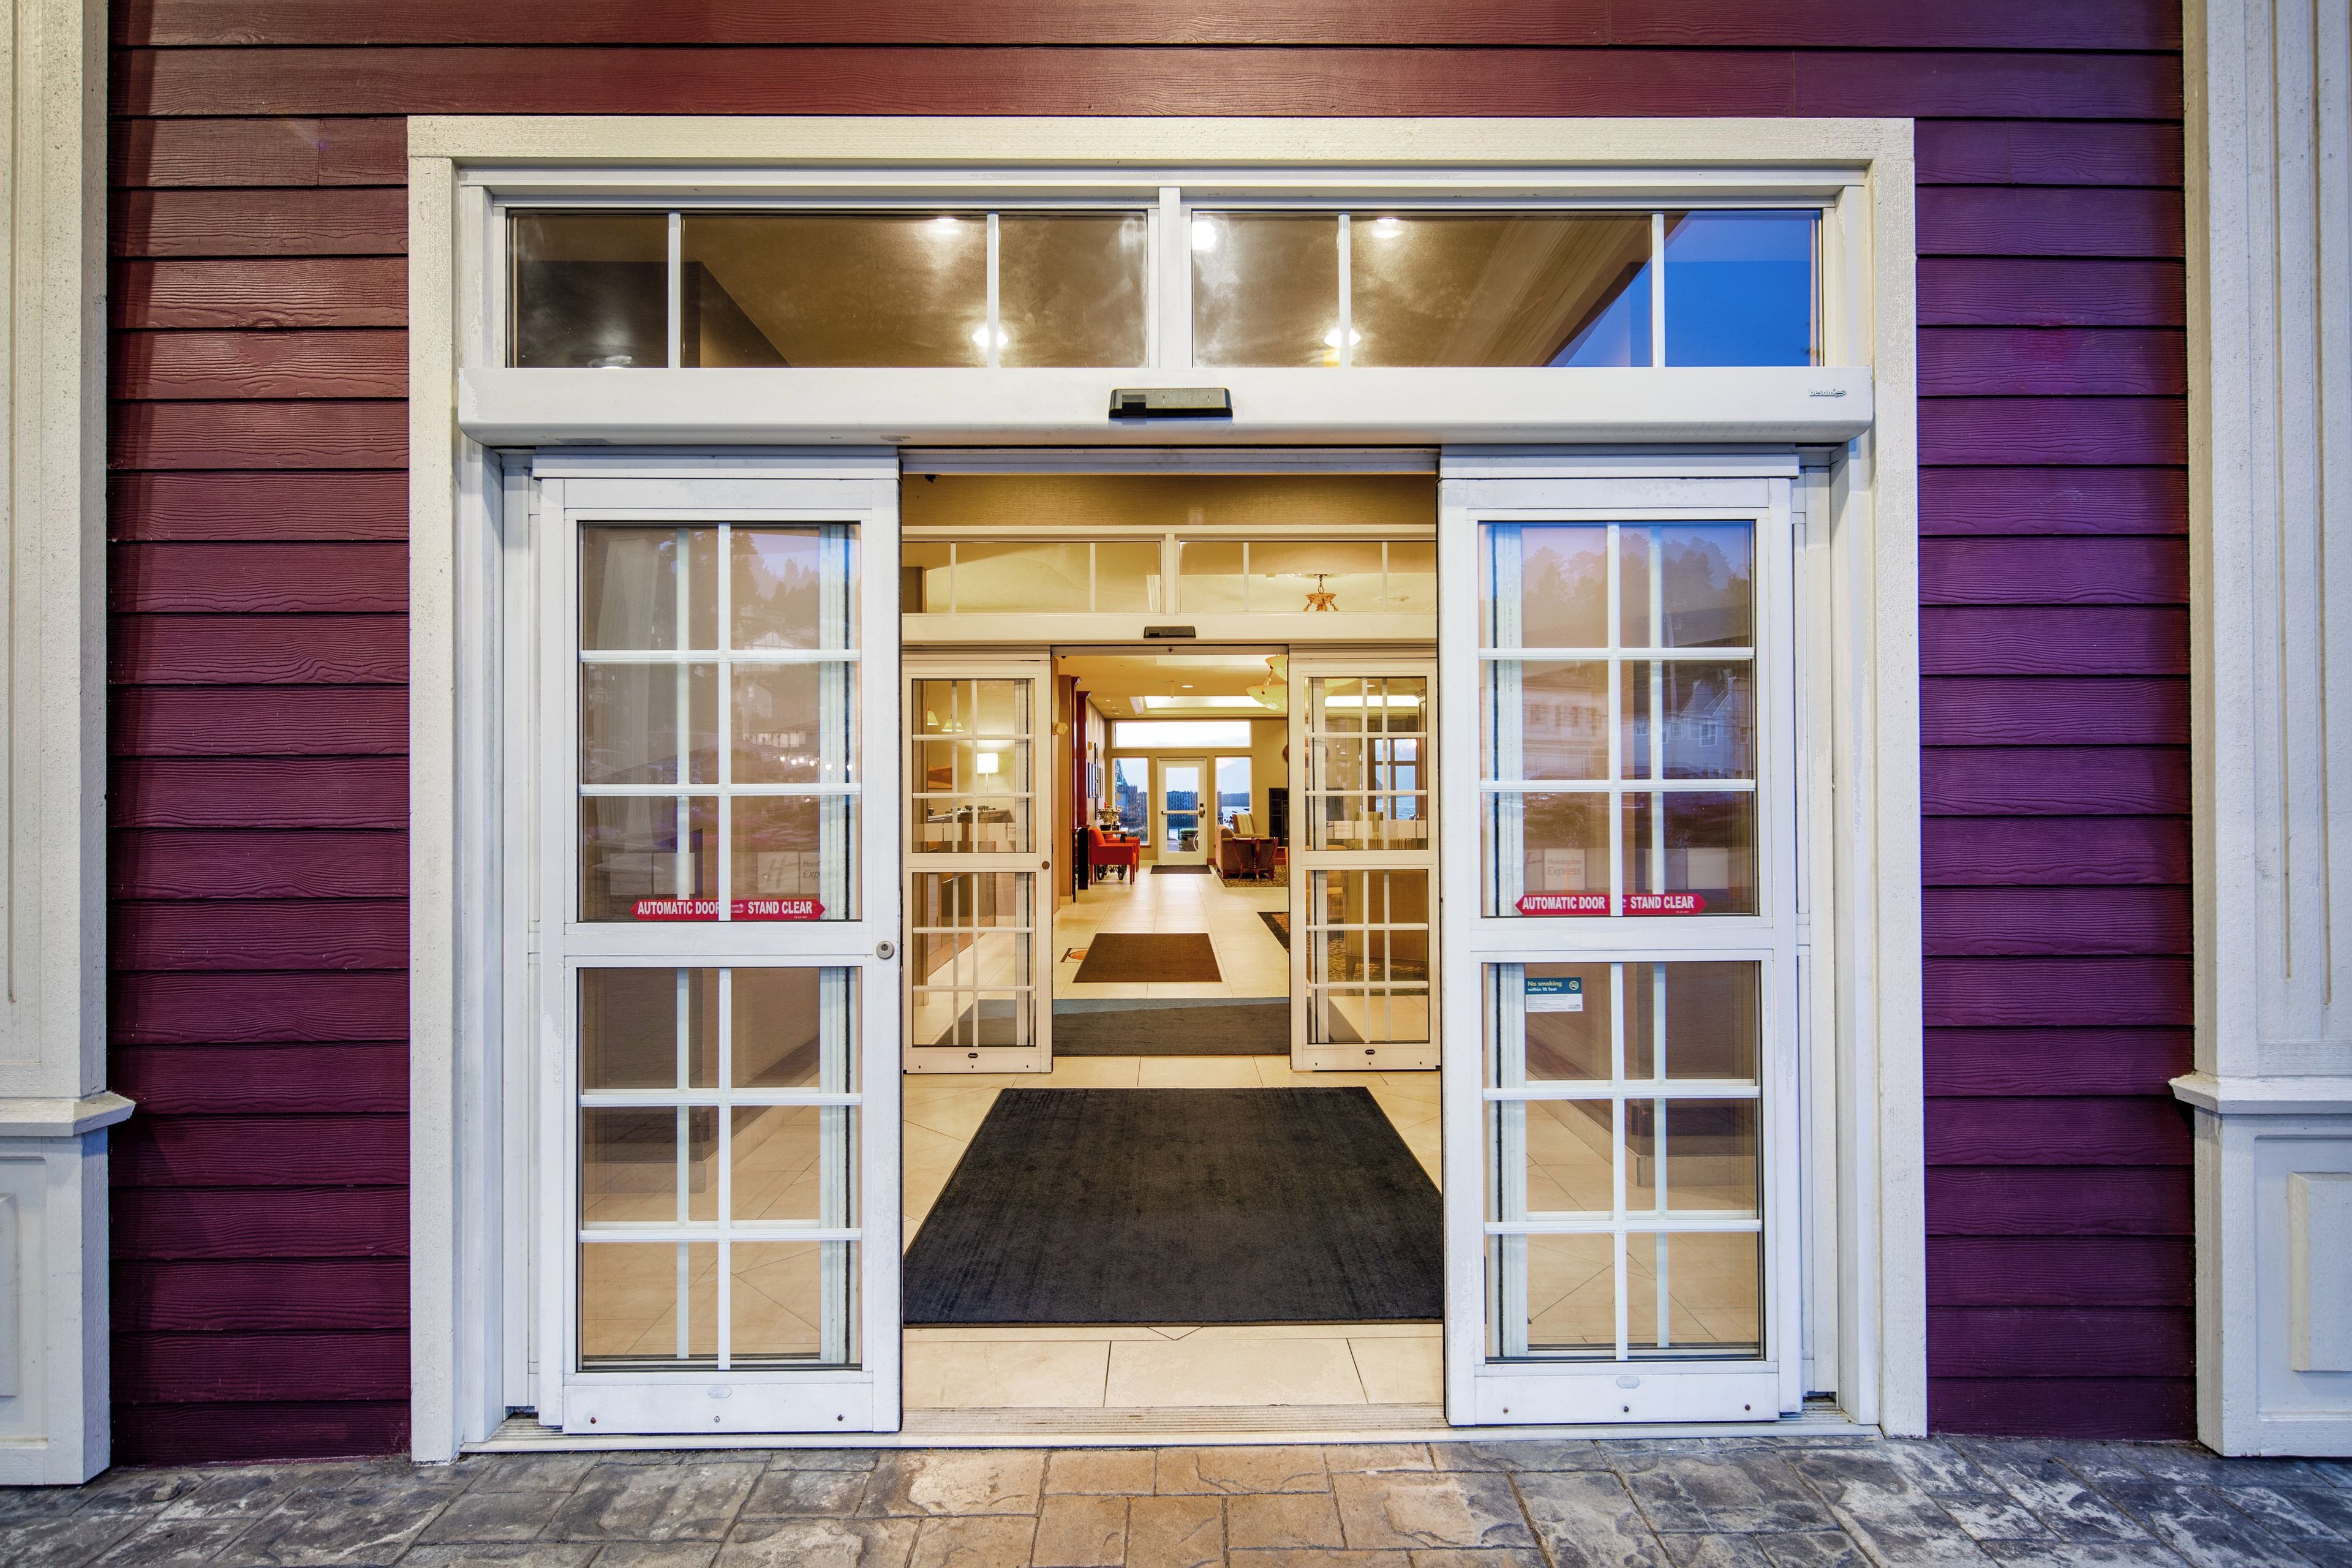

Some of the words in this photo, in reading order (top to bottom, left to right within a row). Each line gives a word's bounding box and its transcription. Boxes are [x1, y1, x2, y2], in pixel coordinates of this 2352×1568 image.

[1547, 867, 1581, 876] Express
[638, 902, 693, 914] AUTOMATIC
[748, 901, 779, 914] STAND
[782, 901, 813, 914] CLEAR
[1522, 897, 1577, 910] AUTOMATIC
[1579, 896, 1605, 909] DOOR
[1630, 896, 1661, 909] STAND
[1664, 896, 1694, 909] CLEAR
